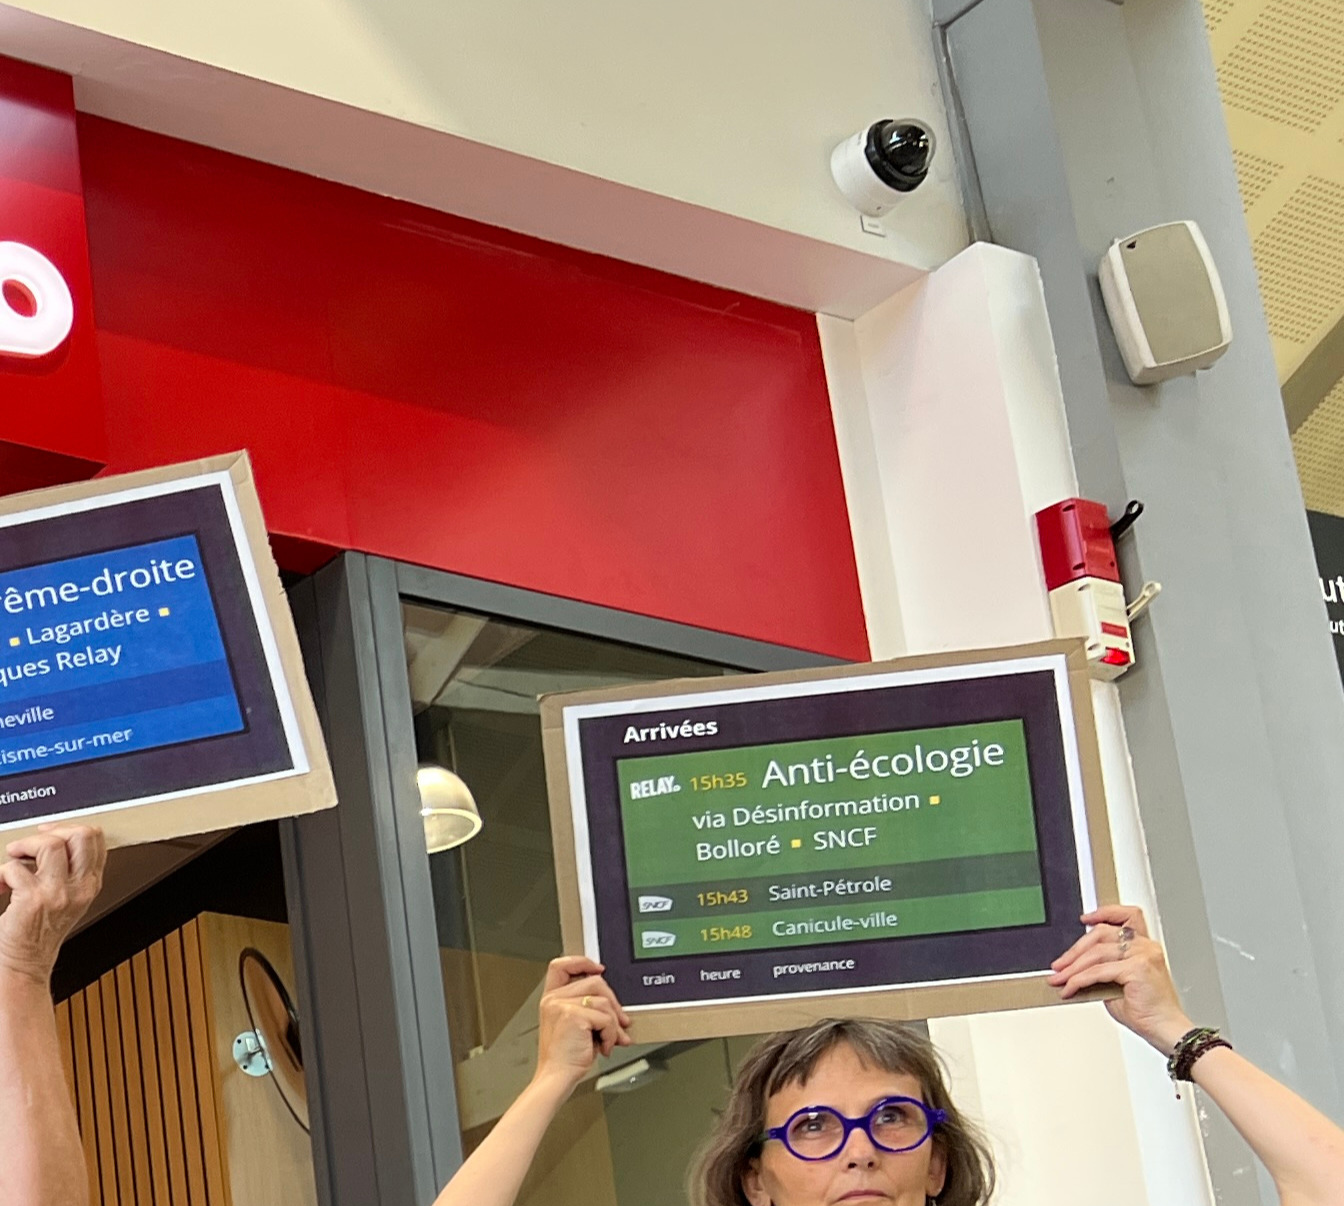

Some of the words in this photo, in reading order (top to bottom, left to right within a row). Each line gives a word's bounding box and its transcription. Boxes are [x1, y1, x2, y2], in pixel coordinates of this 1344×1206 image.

[26, 607, 150, 645] Lagardère
[55, 644, 122, 671] Relay
[623, 719, 719, 744] Arrivées
[690, 772, 748, 791] 15h35
[762, 739, 1004, 789] Anti-écologie
[692, 810, 726, 830] via
[733, 793, 920, 827] Désinformation
[696, 835, 781, 861] Bolloré
[813, 827, 877, 851] SNCF
[697, 889, 749, 907] 15h43
[768, 875, 892, 902] Saint-Pétrole
[700, 925, 752, 942] 15h48
[772, 911, 898, 938] Canicule-ville
[642, 972, 675, 987] train
[700, 967, 741, 982] heure
[772, 957, 856, 979] provenance
